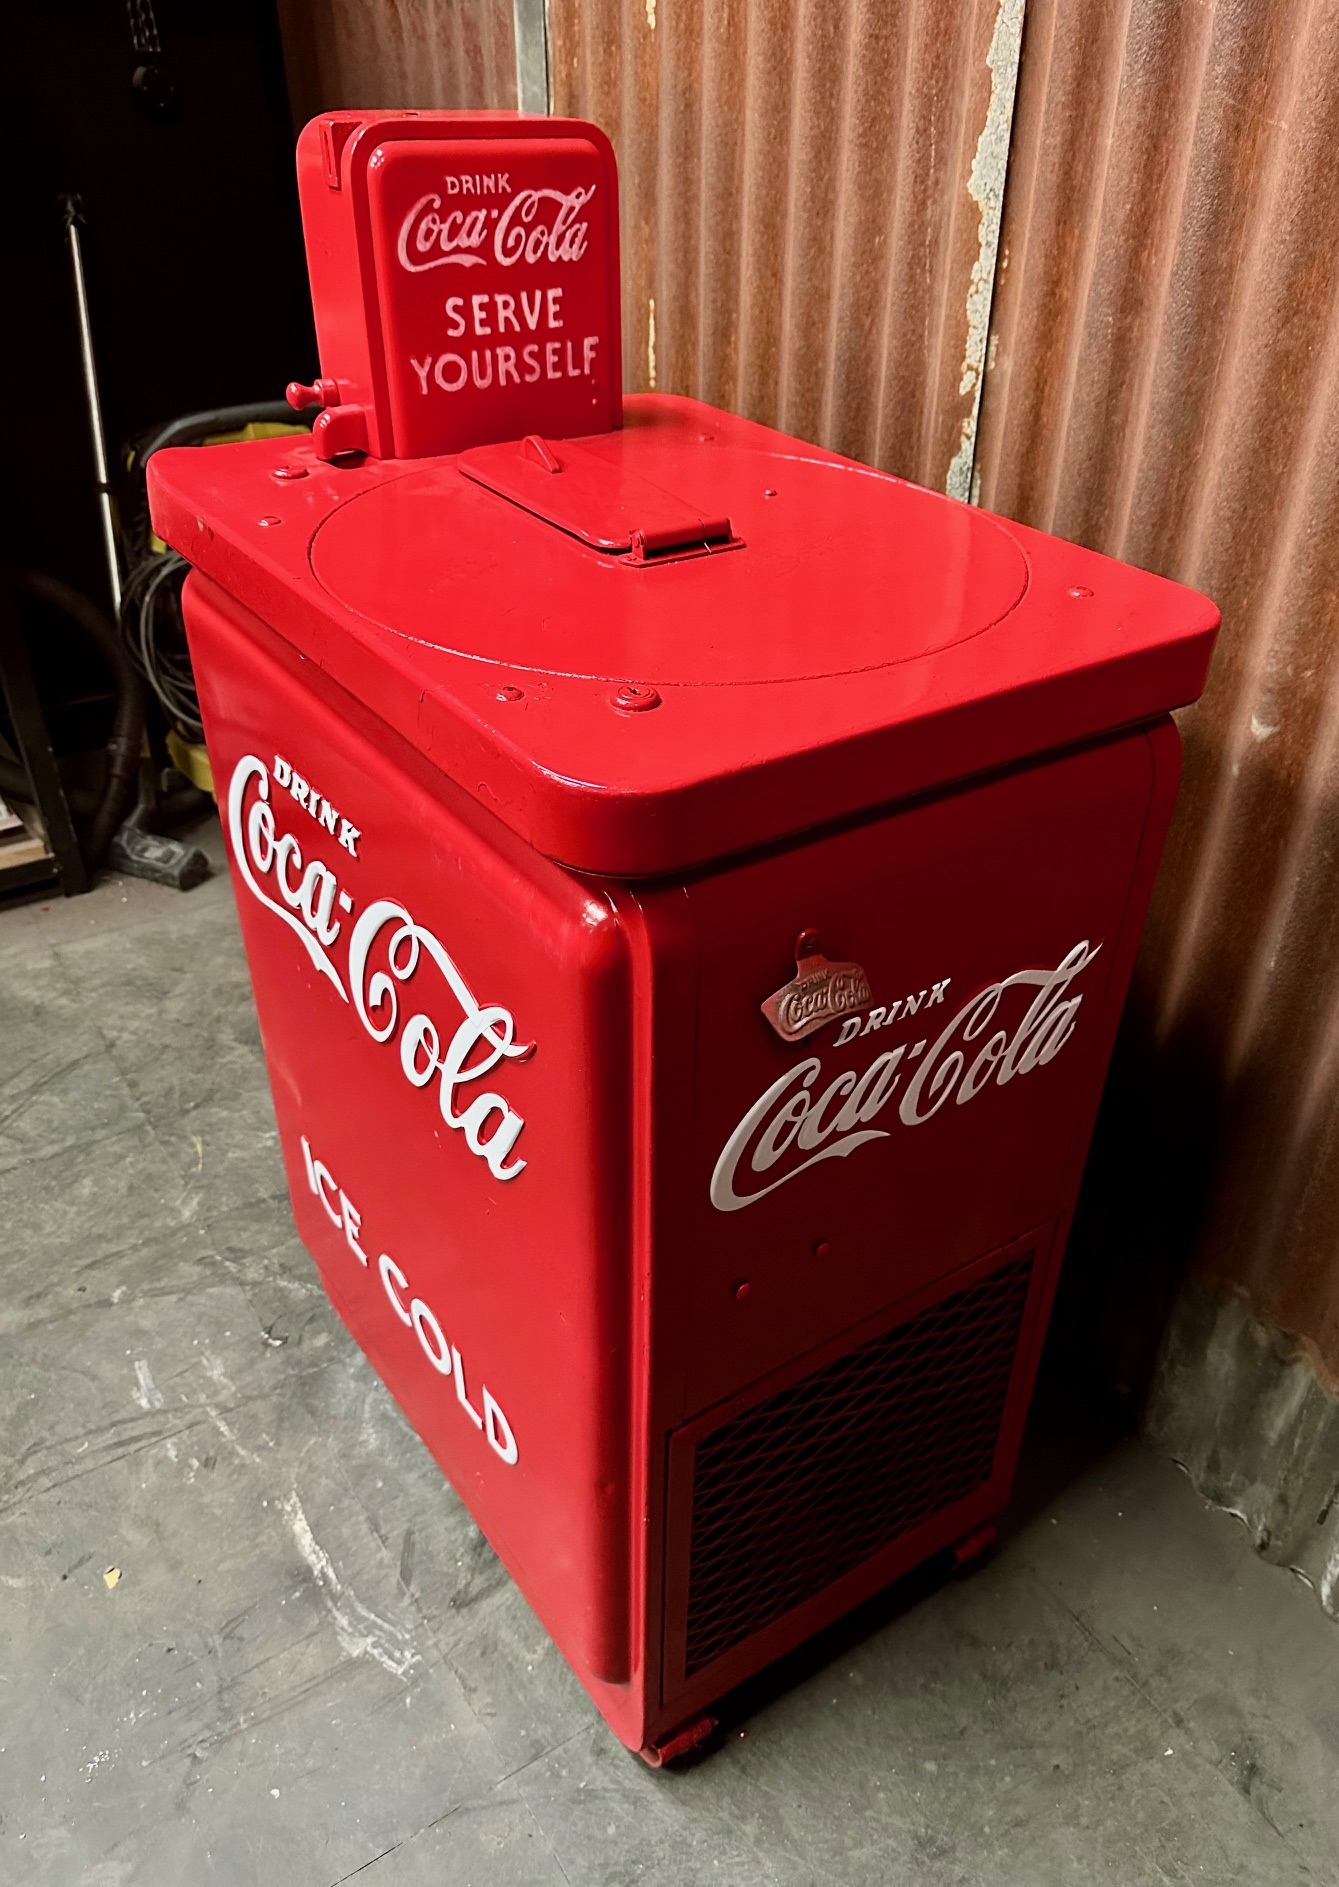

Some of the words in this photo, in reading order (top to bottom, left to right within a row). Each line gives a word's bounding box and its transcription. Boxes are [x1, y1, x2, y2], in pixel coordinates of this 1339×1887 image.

[397, 183, 596, 273] Coca-Cola
[445, 172, 512, 195] DRINK
[445, 287, 564, 337] SERVE
[410, 335, 600, 395] YOURSELF
[273, 754, 361, 858] DRINK
[228, 754, 535, 1181] Coca-Cola
[833, 977, 952, 1047] DRINK
[710, 939, 1104, 1212] Coca-Cola
[301, 1135, 368, 1267] ICE
[379, 1253, 519, 1465] COLD
